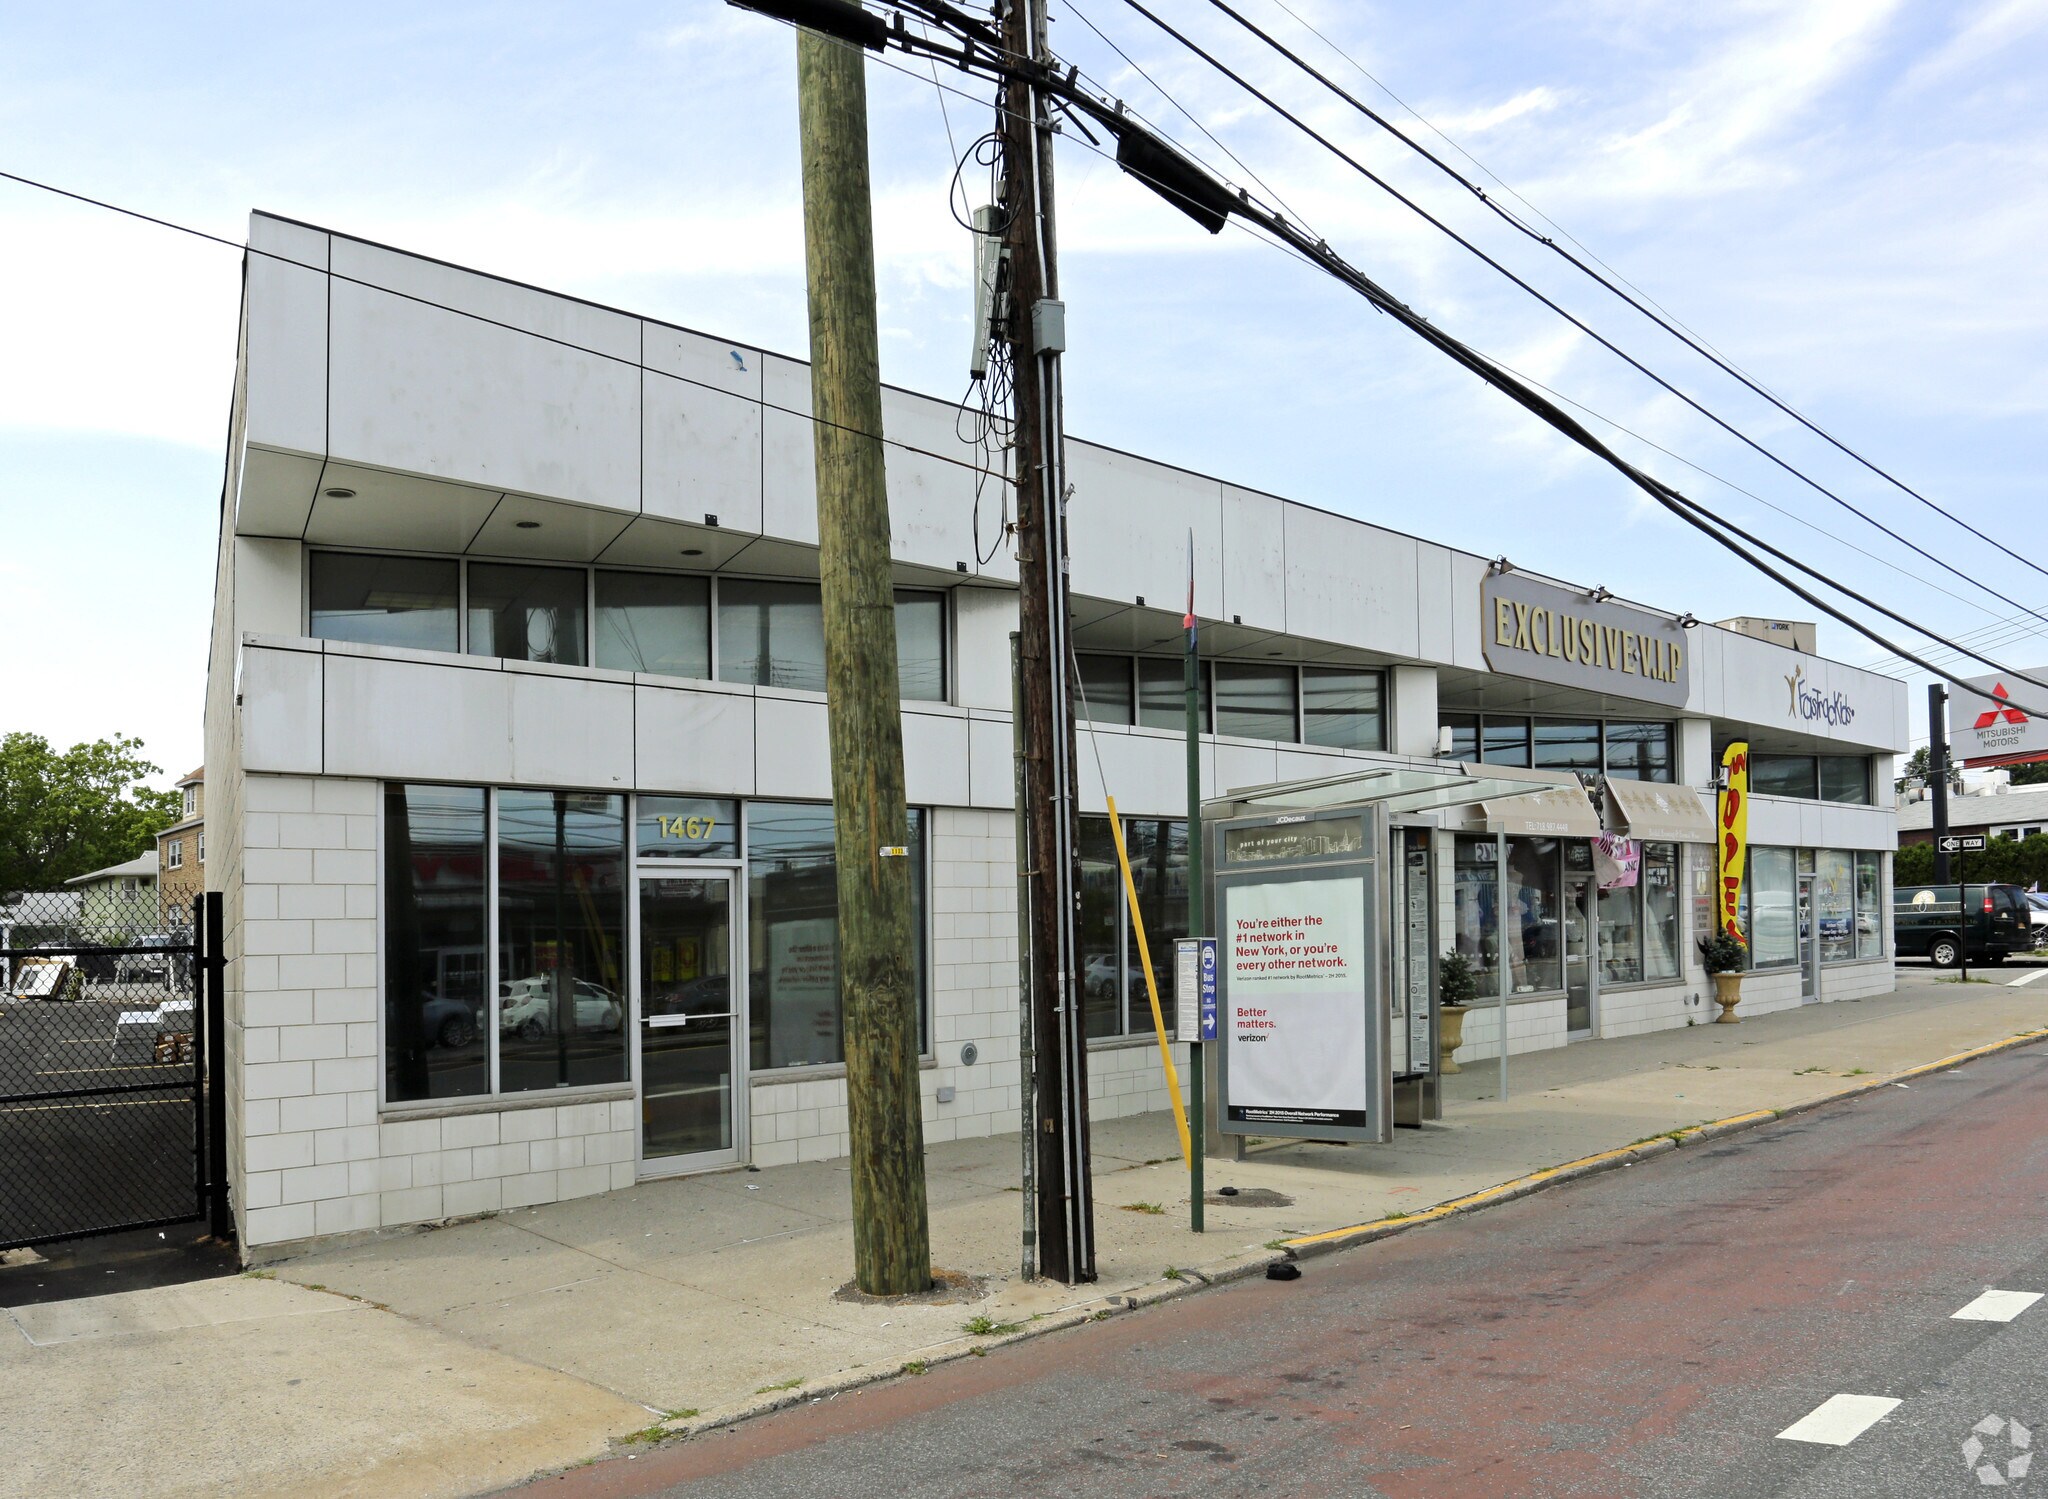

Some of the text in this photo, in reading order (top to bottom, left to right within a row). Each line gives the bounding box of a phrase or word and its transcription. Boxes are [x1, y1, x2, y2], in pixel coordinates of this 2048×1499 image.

[1776, 623, 1790, 631] YORK
[1494, 596, 1635, 675] EXCLUSIVE
[1976, 726, 2026, 740] MITSUBISHI
[1983, 736, 2019, 749] MOTORS
[1275, 815, 1306, 824] JCDecaux
[658, 815, 715, 839] 1467
[1266, 838, 1281, 847] your
[1283, 835, 1298, 844] city
[1236, 915, 1323, 930] You're either the
[1236, 930, 1305, 943] #1 network in
[1236, 943, 1338, 957] New York, or you're
[1236, 956, 1347, 972] every other network.
[1203, 972, 1214, 982] Bus
[1202, 983, 1215, 994] Stop
[1237, 1007, 1267, 1017] Better
[1237, 1020, 1277, 1028] matters.
[1237, 1034, 1267, 1042] verizon
